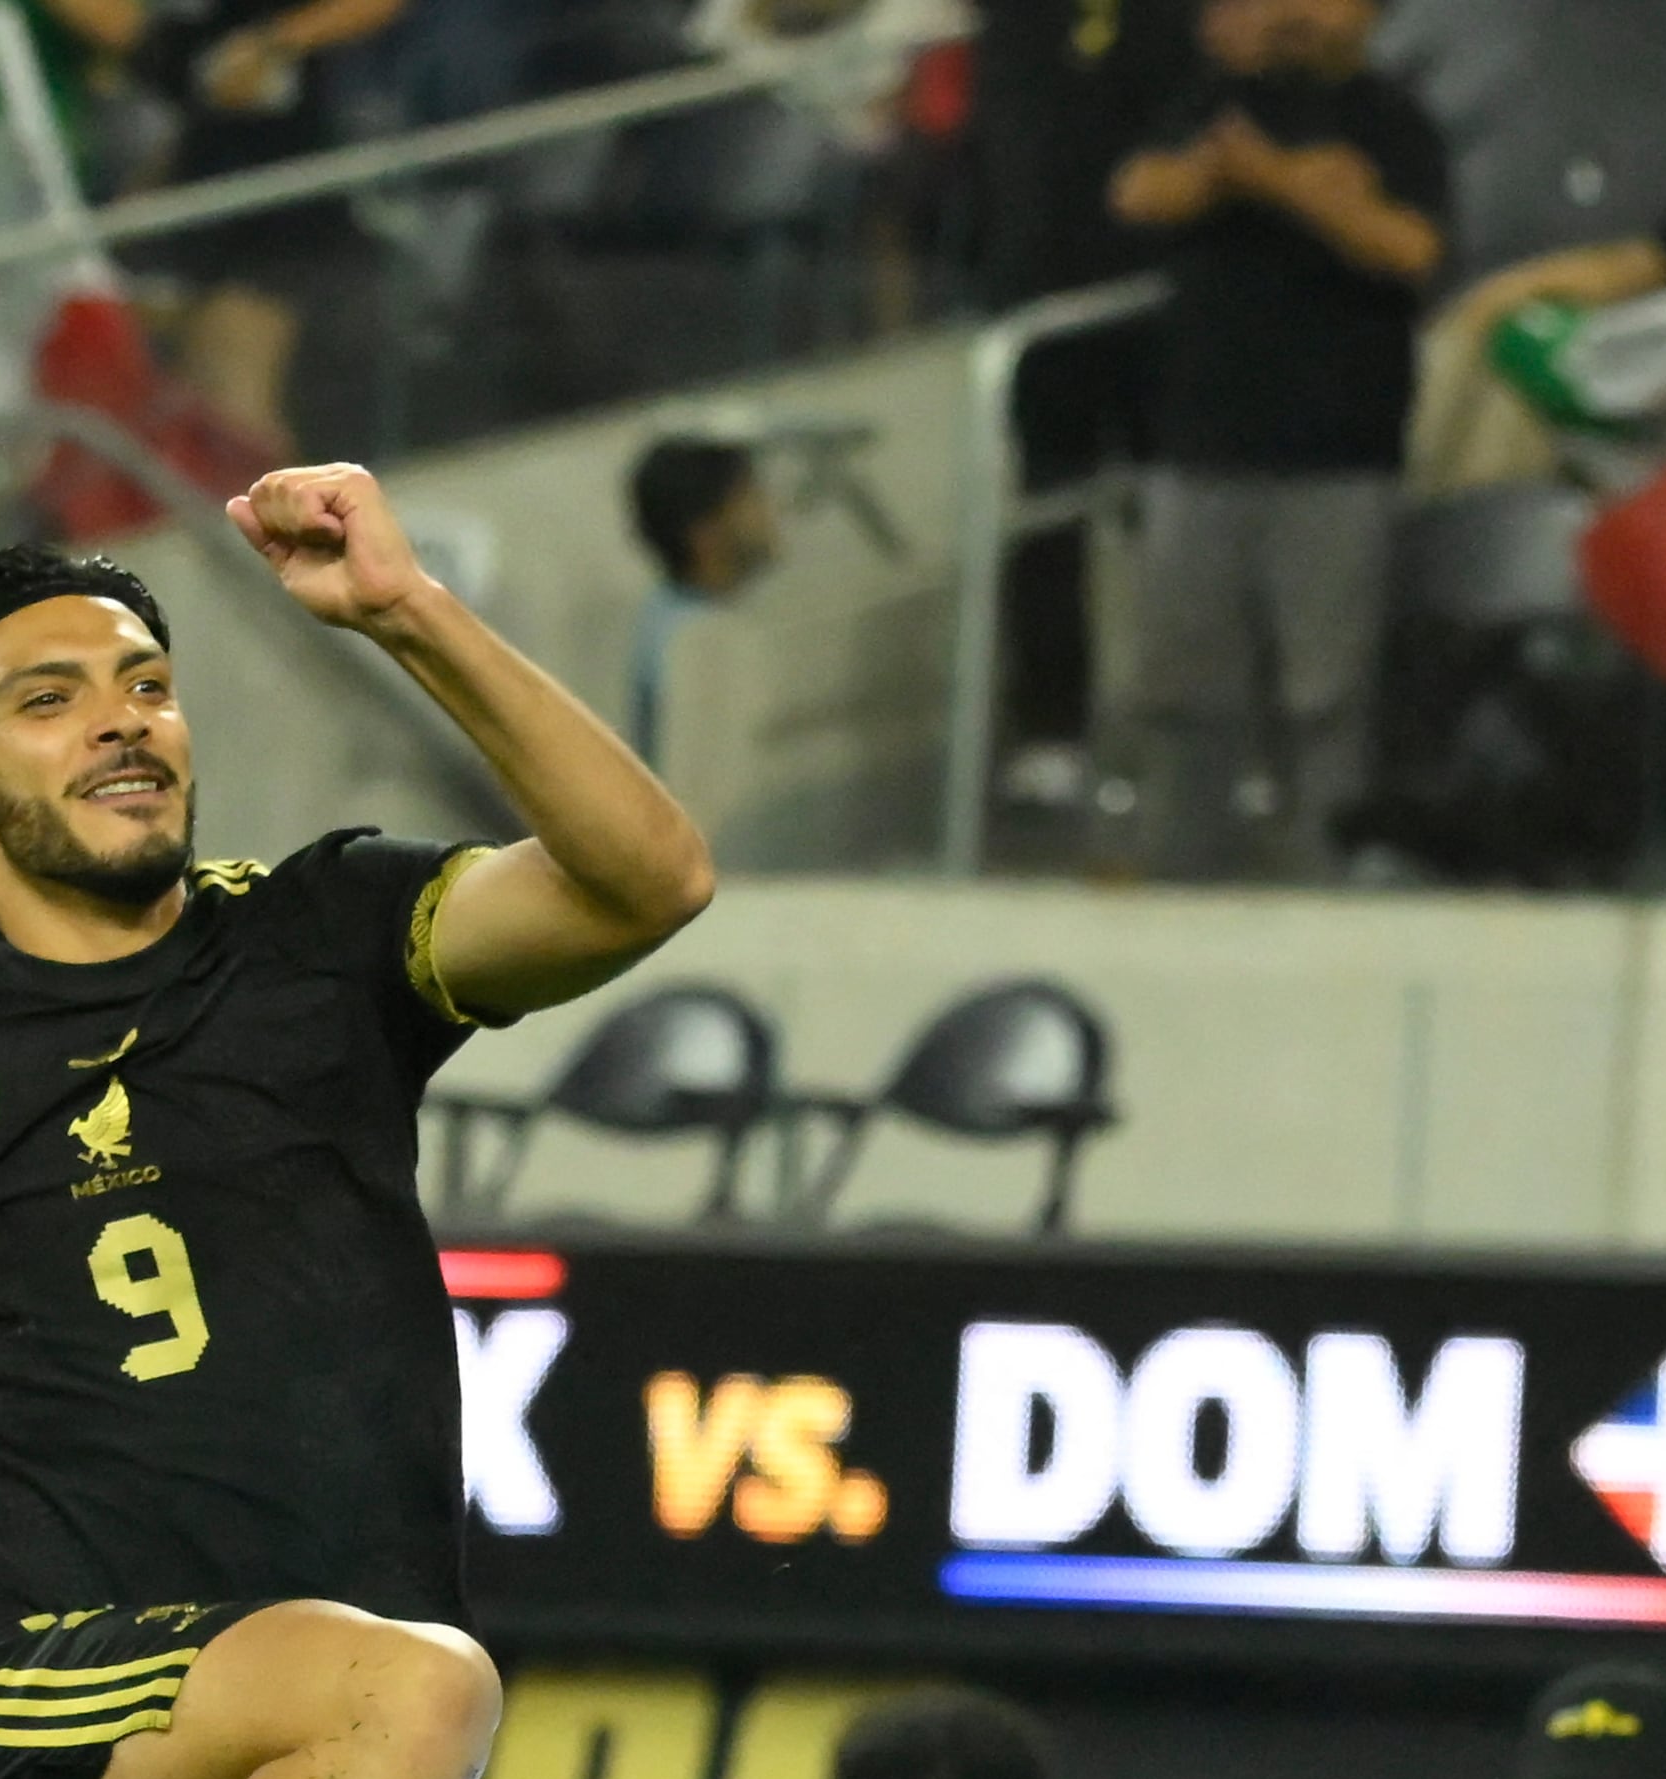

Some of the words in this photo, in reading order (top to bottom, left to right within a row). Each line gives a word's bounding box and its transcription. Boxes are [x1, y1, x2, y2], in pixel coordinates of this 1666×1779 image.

[70, 1164, 162, 1200] MÉXICO
[88, 1214, 209, 1382] 9
[948, 1320, 1527, 1563] DOM
